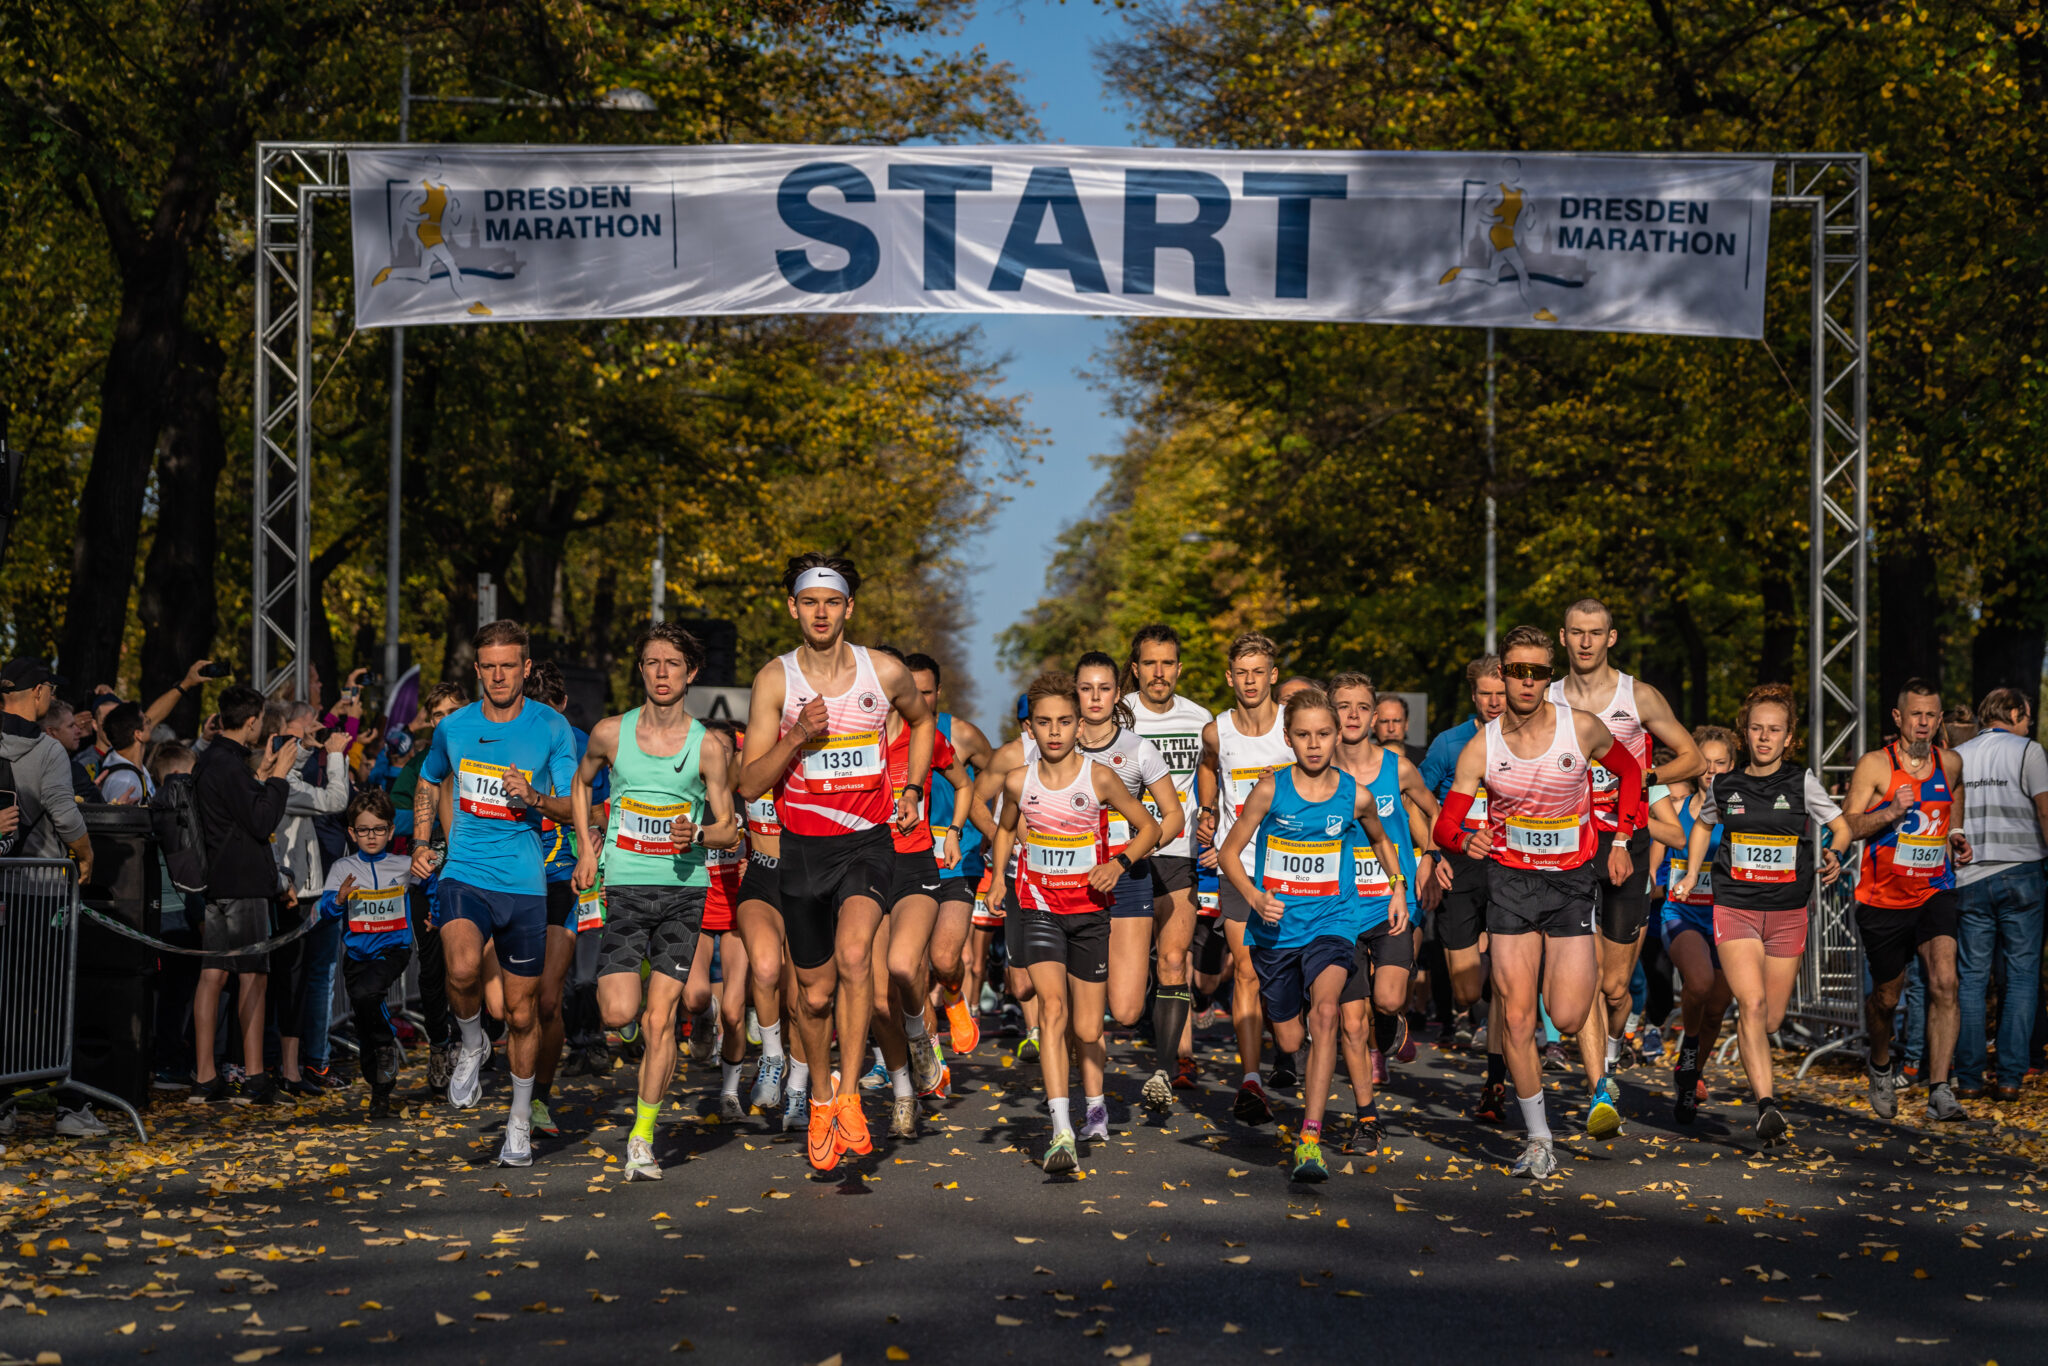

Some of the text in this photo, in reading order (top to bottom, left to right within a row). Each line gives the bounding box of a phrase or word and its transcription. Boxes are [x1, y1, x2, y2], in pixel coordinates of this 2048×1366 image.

[484, 184, 632, 212] DRESDEN
[1560, 197, 1709, 225] DRESDEN
[484, 213, 662, 242] MARATHON
[775, 162, 1348, 299] START
[1558, 226, 1736, 256] MARATHON
[1169, 738, 1199, 751] TILL
[822, 750, 863, 769] 1330
[834, 783, 864, 791] Sparkasse
[481, 796, 500, 804] Andre
[478, 808, 506, 817] Sparkasse
[641, 834, 667, 842] Charles
[1525, 831, 1559, 847] 1331
[643, 846, 673, 854] Sparkasse
[1746, 847, 1782, 863] 1282
[1912, 848, 1938, 861] 1367
[1041, 849, 1076, 867] 1177
[1282, 855, 1325, 873] 1008
[1532, 858, 1560, 866] Sparkasse
[1048, 880, 1079, 888] Sparkasse
[1291, 886, 1320, 894] Sparkasse
[362, 900, 394, 915] 1064
